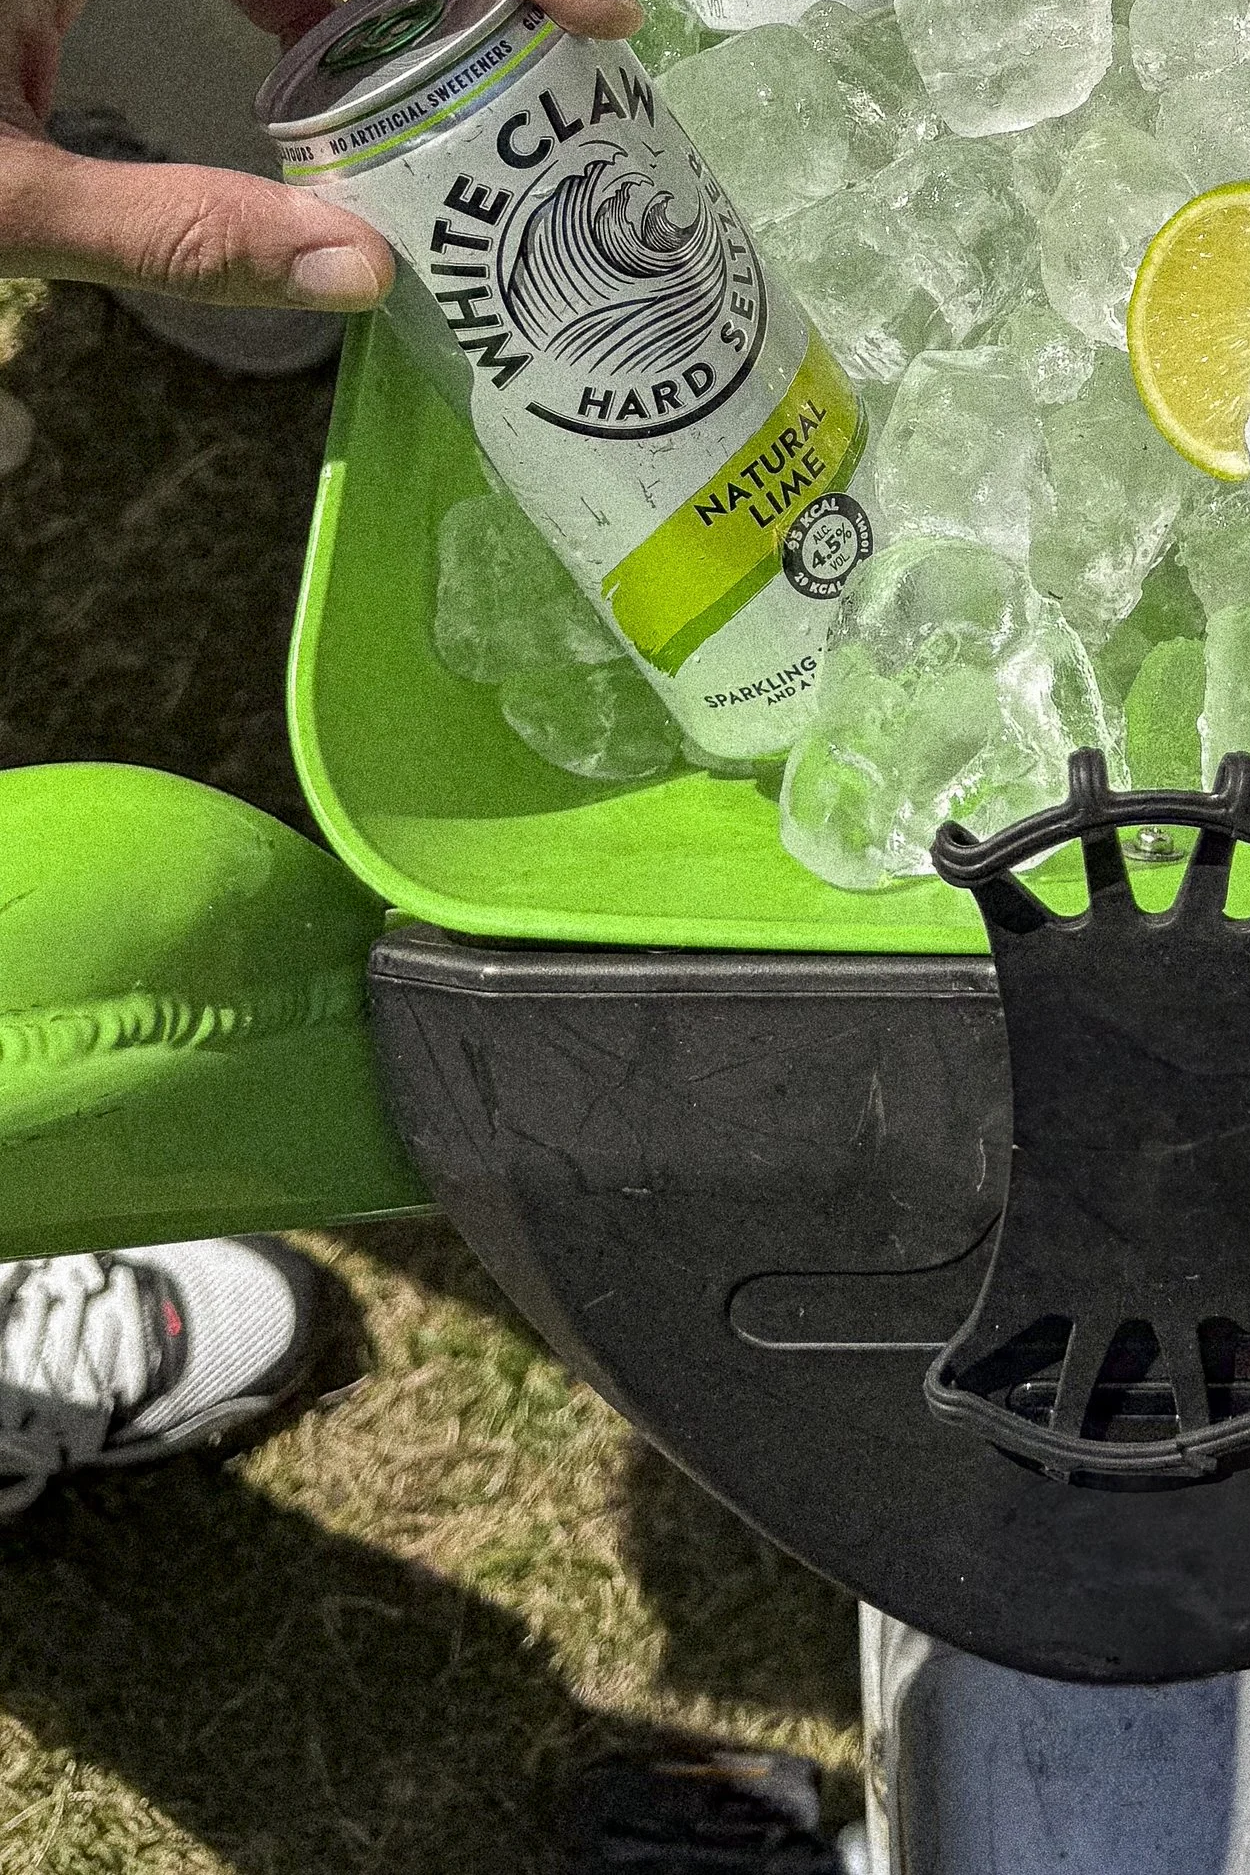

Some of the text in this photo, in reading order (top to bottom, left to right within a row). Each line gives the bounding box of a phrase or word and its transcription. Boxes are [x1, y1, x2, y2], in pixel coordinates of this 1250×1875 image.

[329, 137, 348, 156] NO
[349, 101, 427, 151] ARTIFICIAL
[429, 39, 514, 108] SWEETENERS
[429, 66, 657, 391] WHITE CLAW
[576, 361, 718, 424] HARD
[692, 399, 828, 527] NATURAL
[748, 446, 828, 529] LIME
[800, 497, 840, 528] KCAL
[812, 522, 852, 569] 4.5%
[808, 580, 843, 595] KCAL
[704, 655, 818, 708] SPARKLING
[766, 679, 812, 706] AND A
